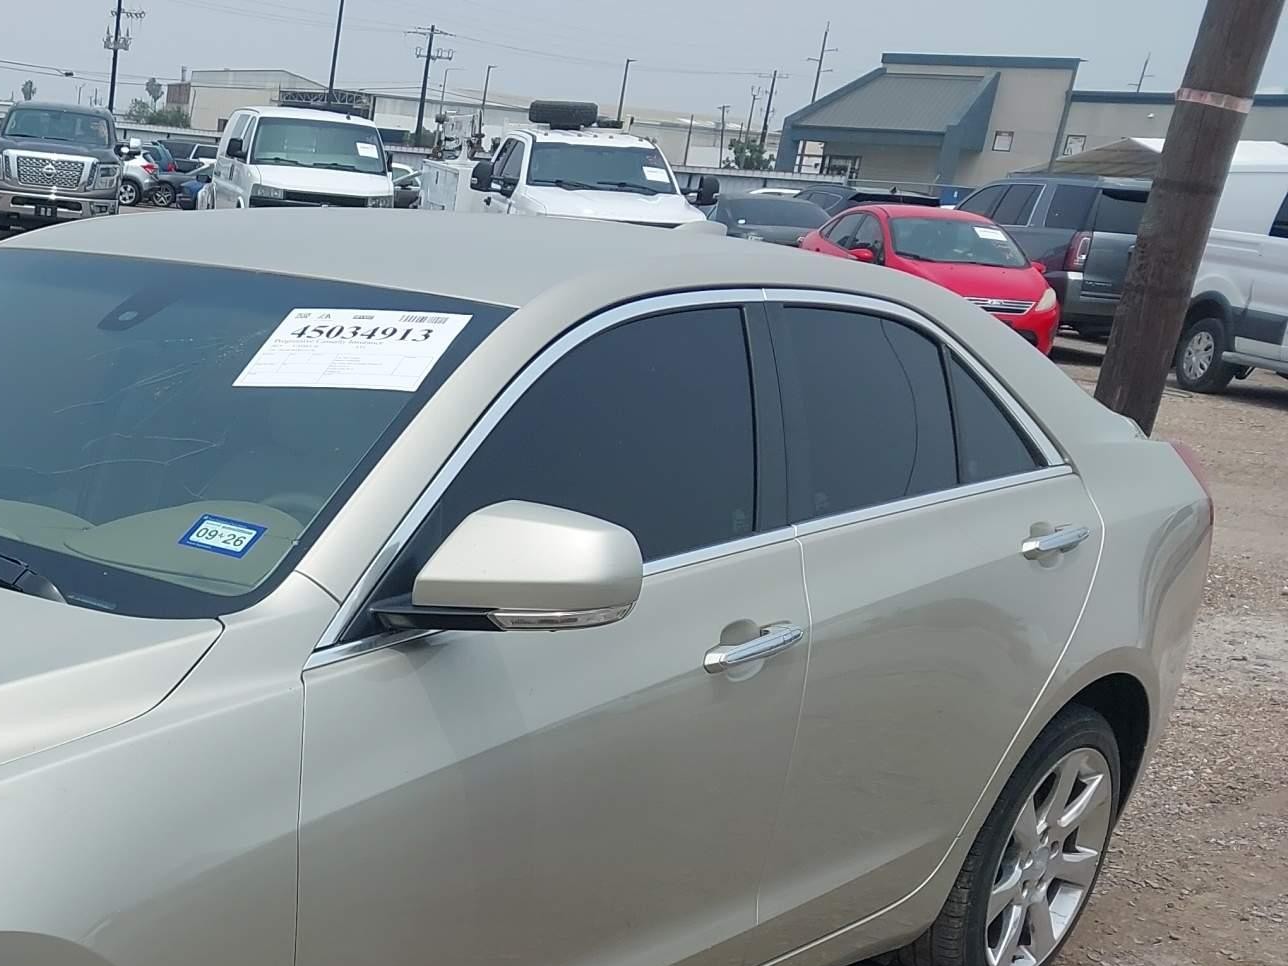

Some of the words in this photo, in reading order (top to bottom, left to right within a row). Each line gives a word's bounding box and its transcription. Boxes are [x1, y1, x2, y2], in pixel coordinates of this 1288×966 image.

[290, 324, 434, 342] 45034913
[196, 528, 219, 540] 09
[222, 534, 247, 547] 26
